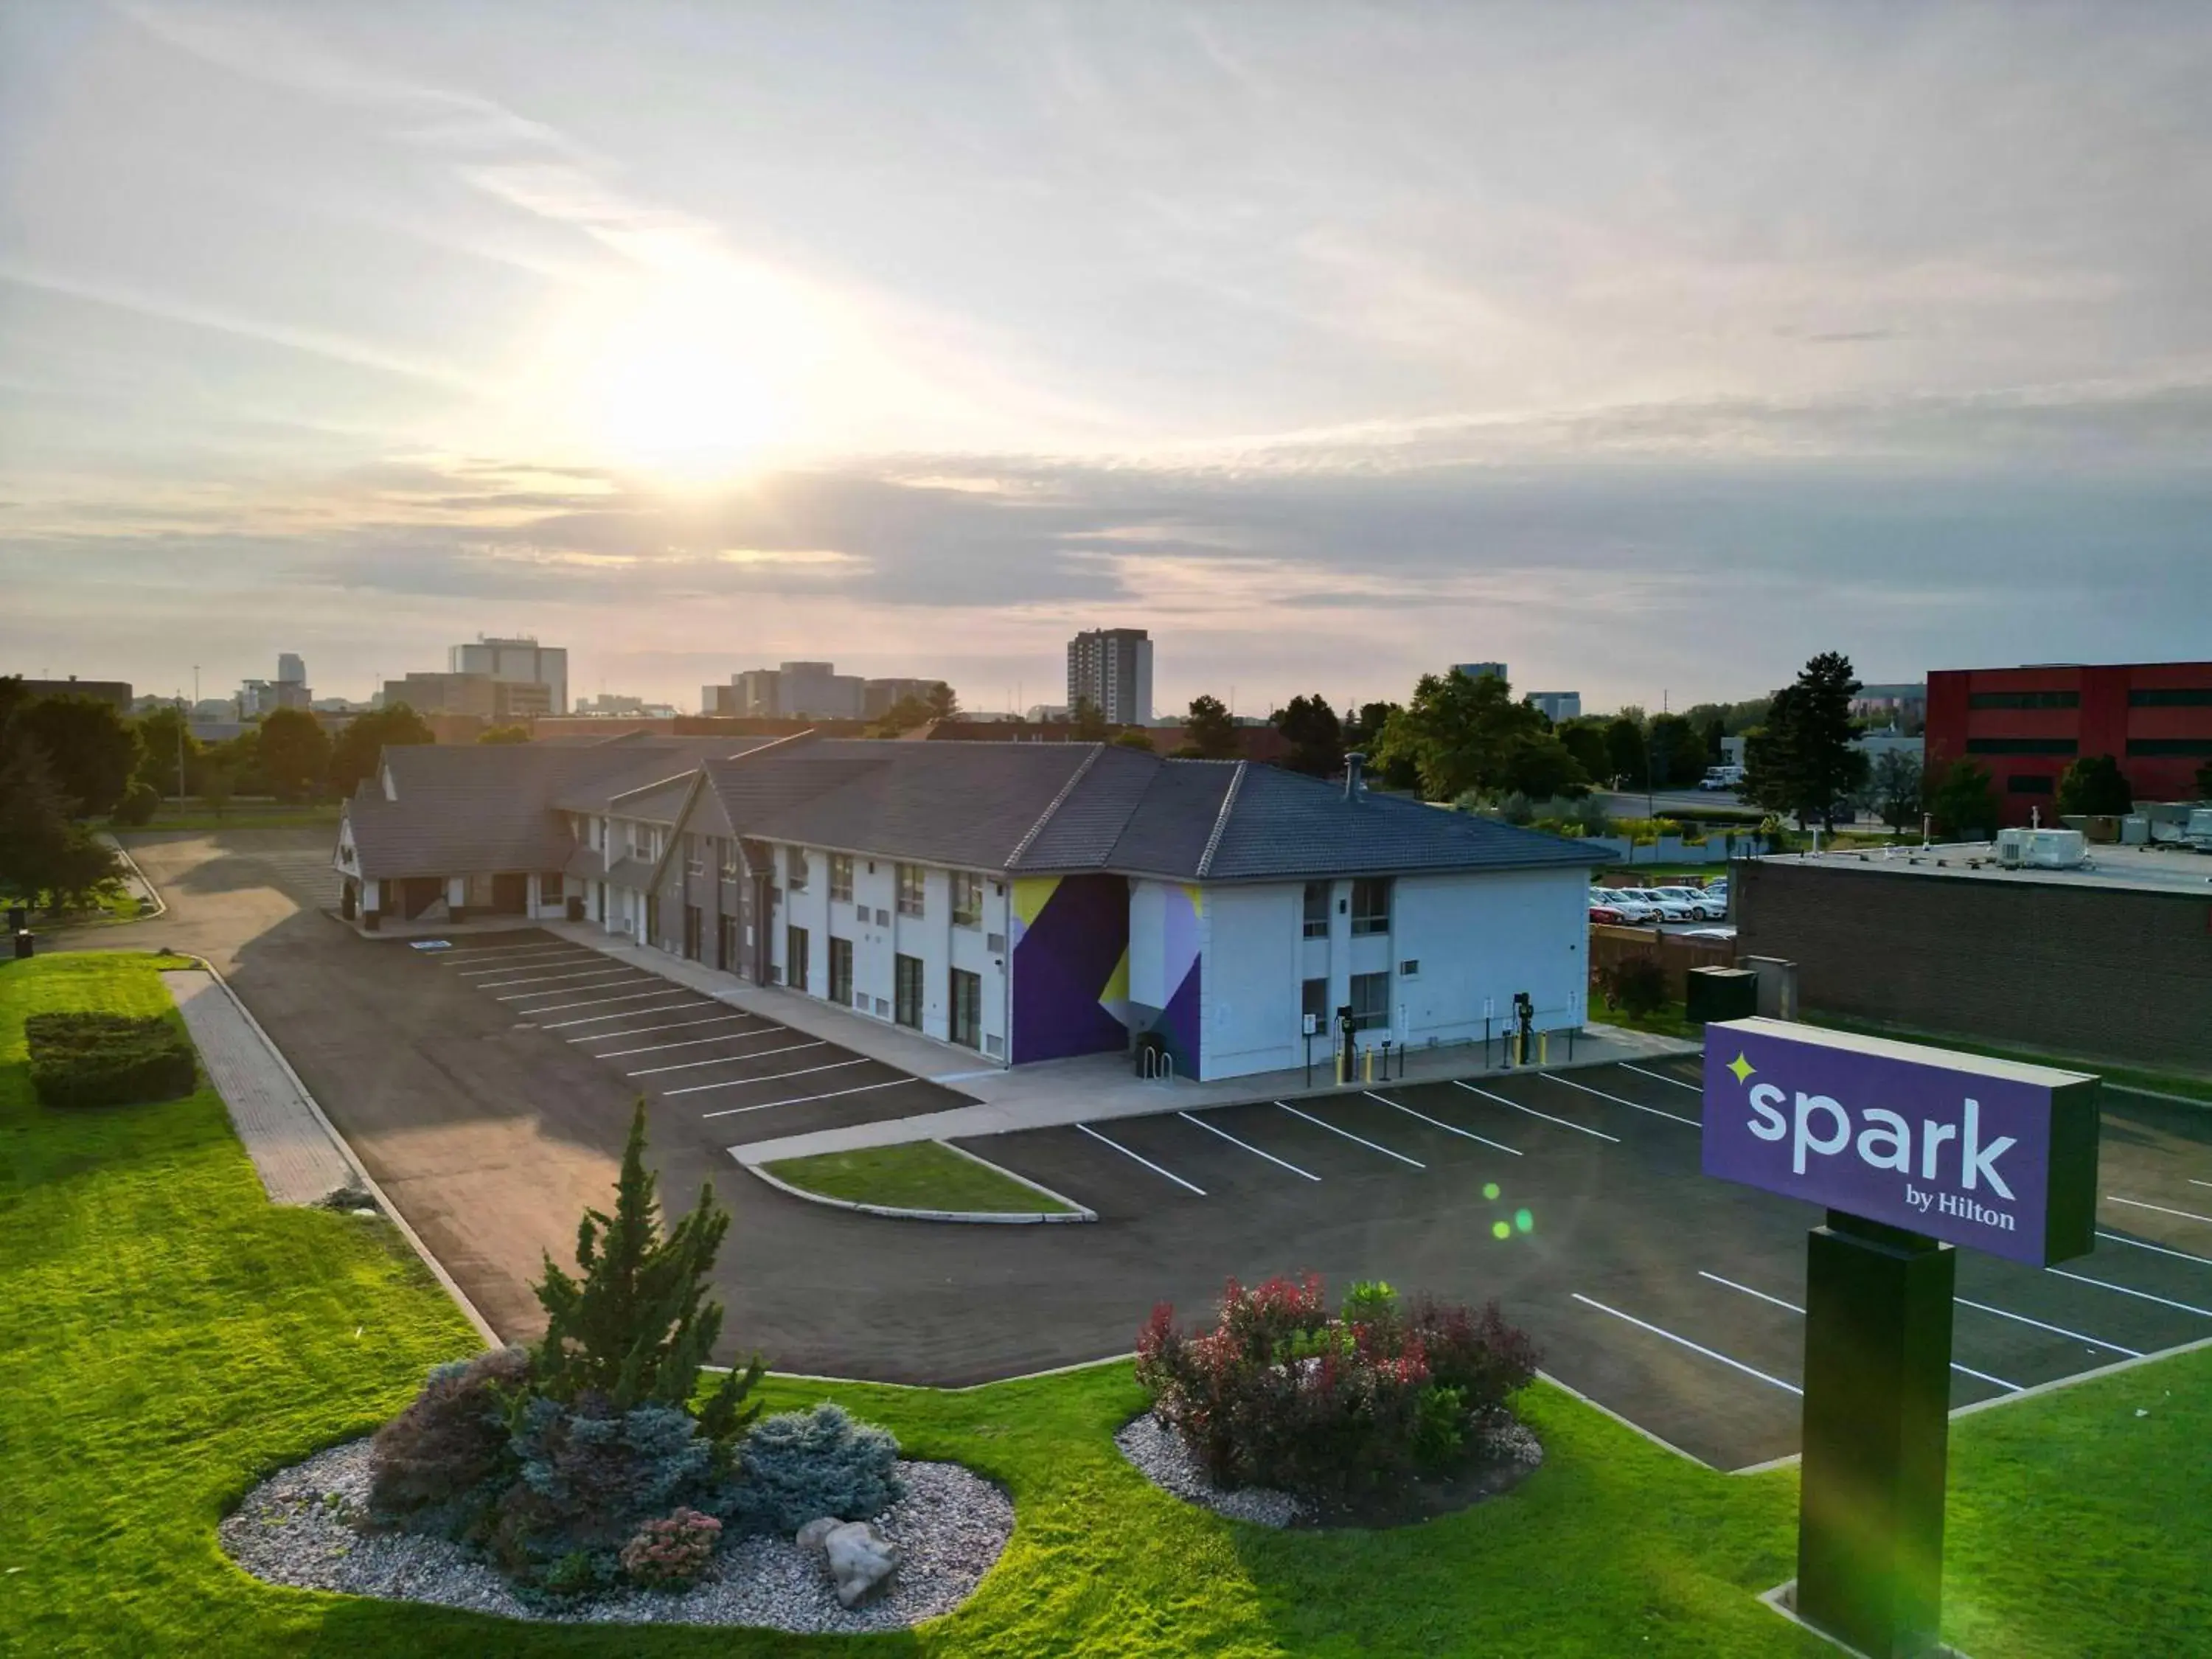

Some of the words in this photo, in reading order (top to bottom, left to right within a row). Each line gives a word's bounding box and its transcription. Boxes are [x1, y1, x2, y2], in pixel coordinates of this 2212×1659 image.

[1746, 1082, 2018, 1202] spark
[1905, 1183, 1933, 1213] by
[1938, 1192, 2016, 1231] Hilton
